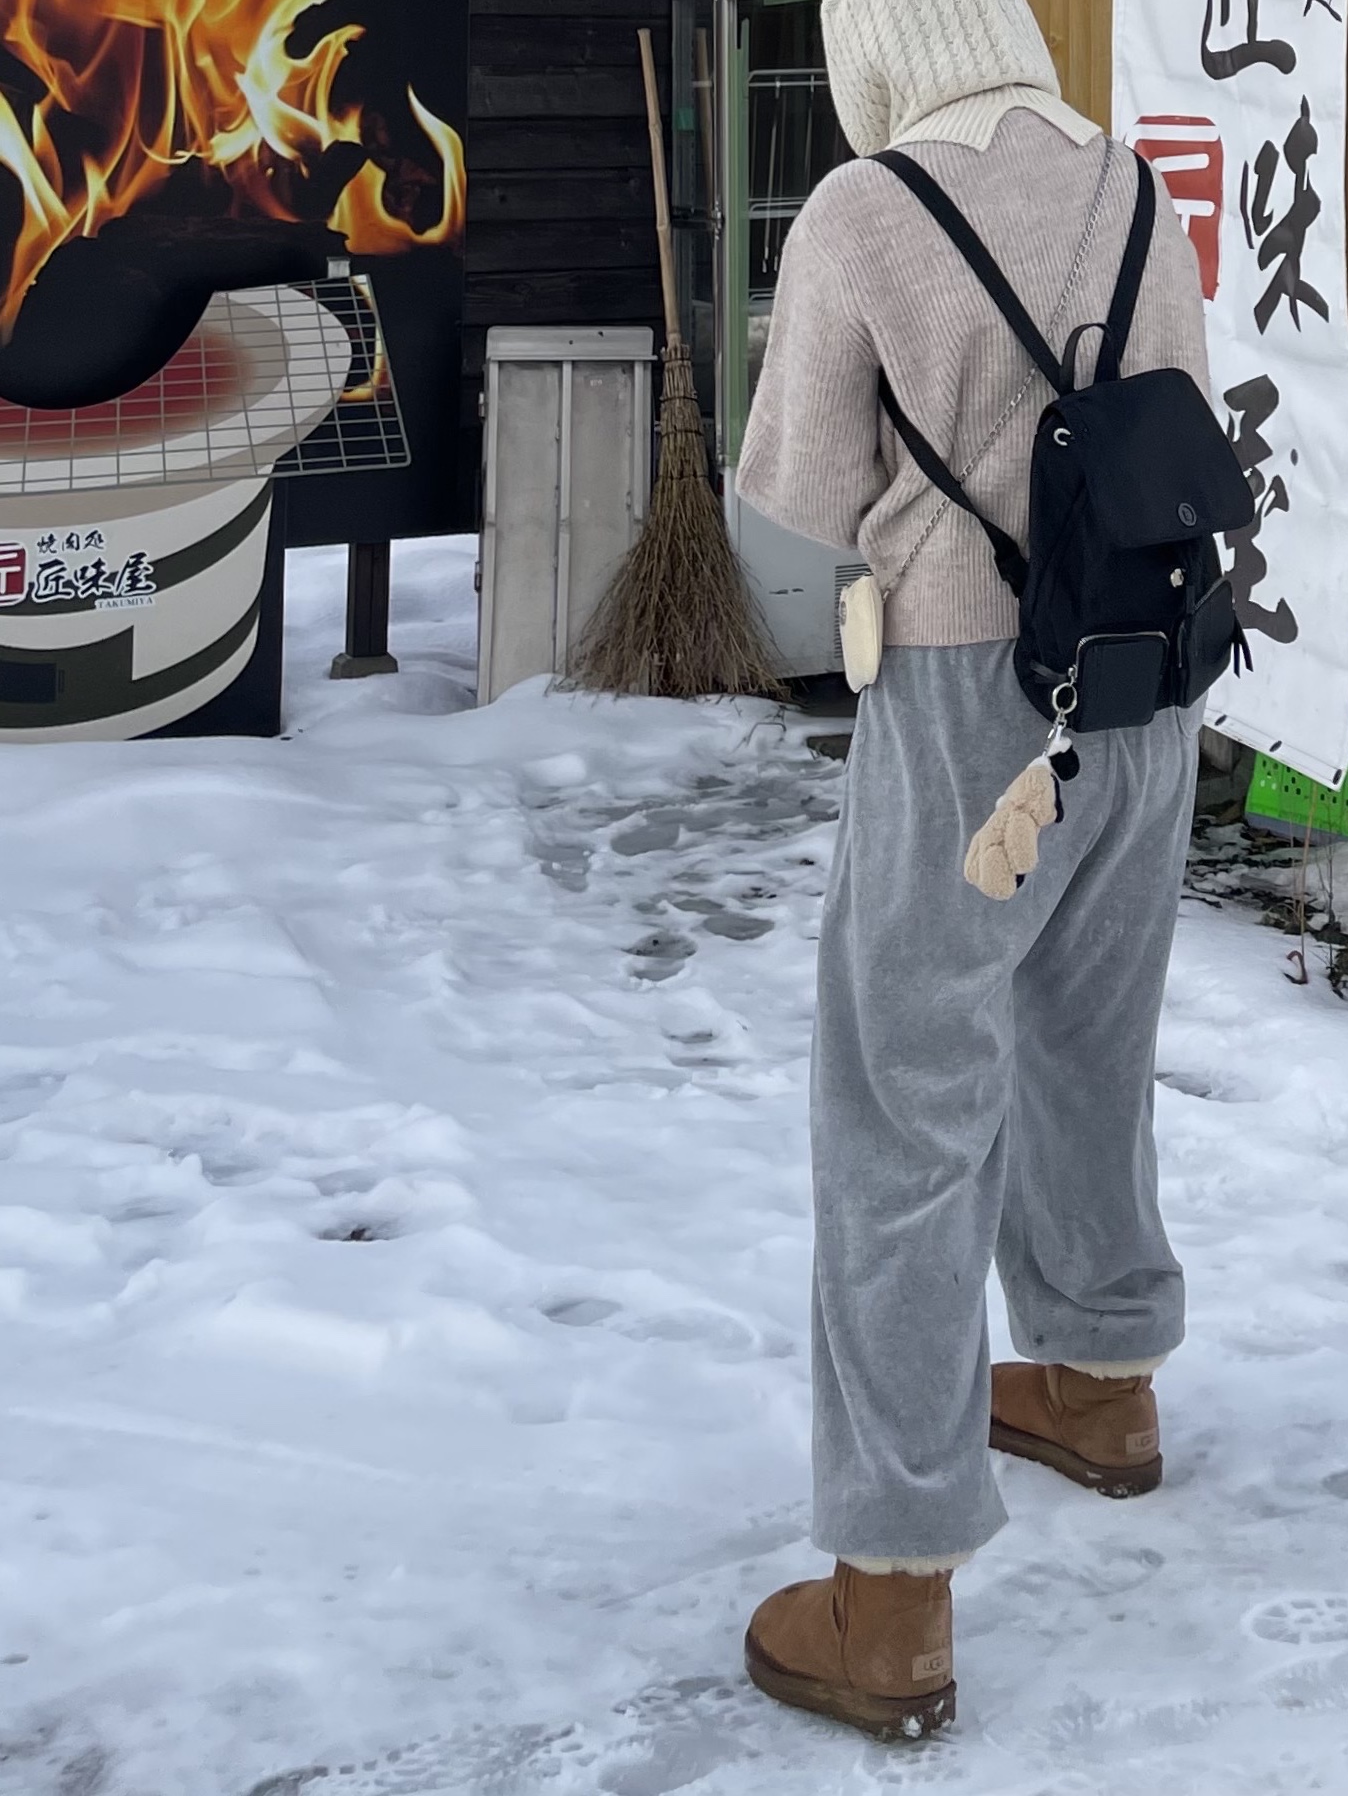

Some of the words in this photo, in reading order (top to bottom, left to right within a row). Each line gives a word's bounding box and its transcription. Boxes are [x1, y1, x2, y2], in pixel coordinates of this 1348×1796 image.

[37, 529, 105, 554] 焼肉処
[36, 552, 154, 598] 匠味屋
[99, 598, 153, 609] TAKUMIYA
